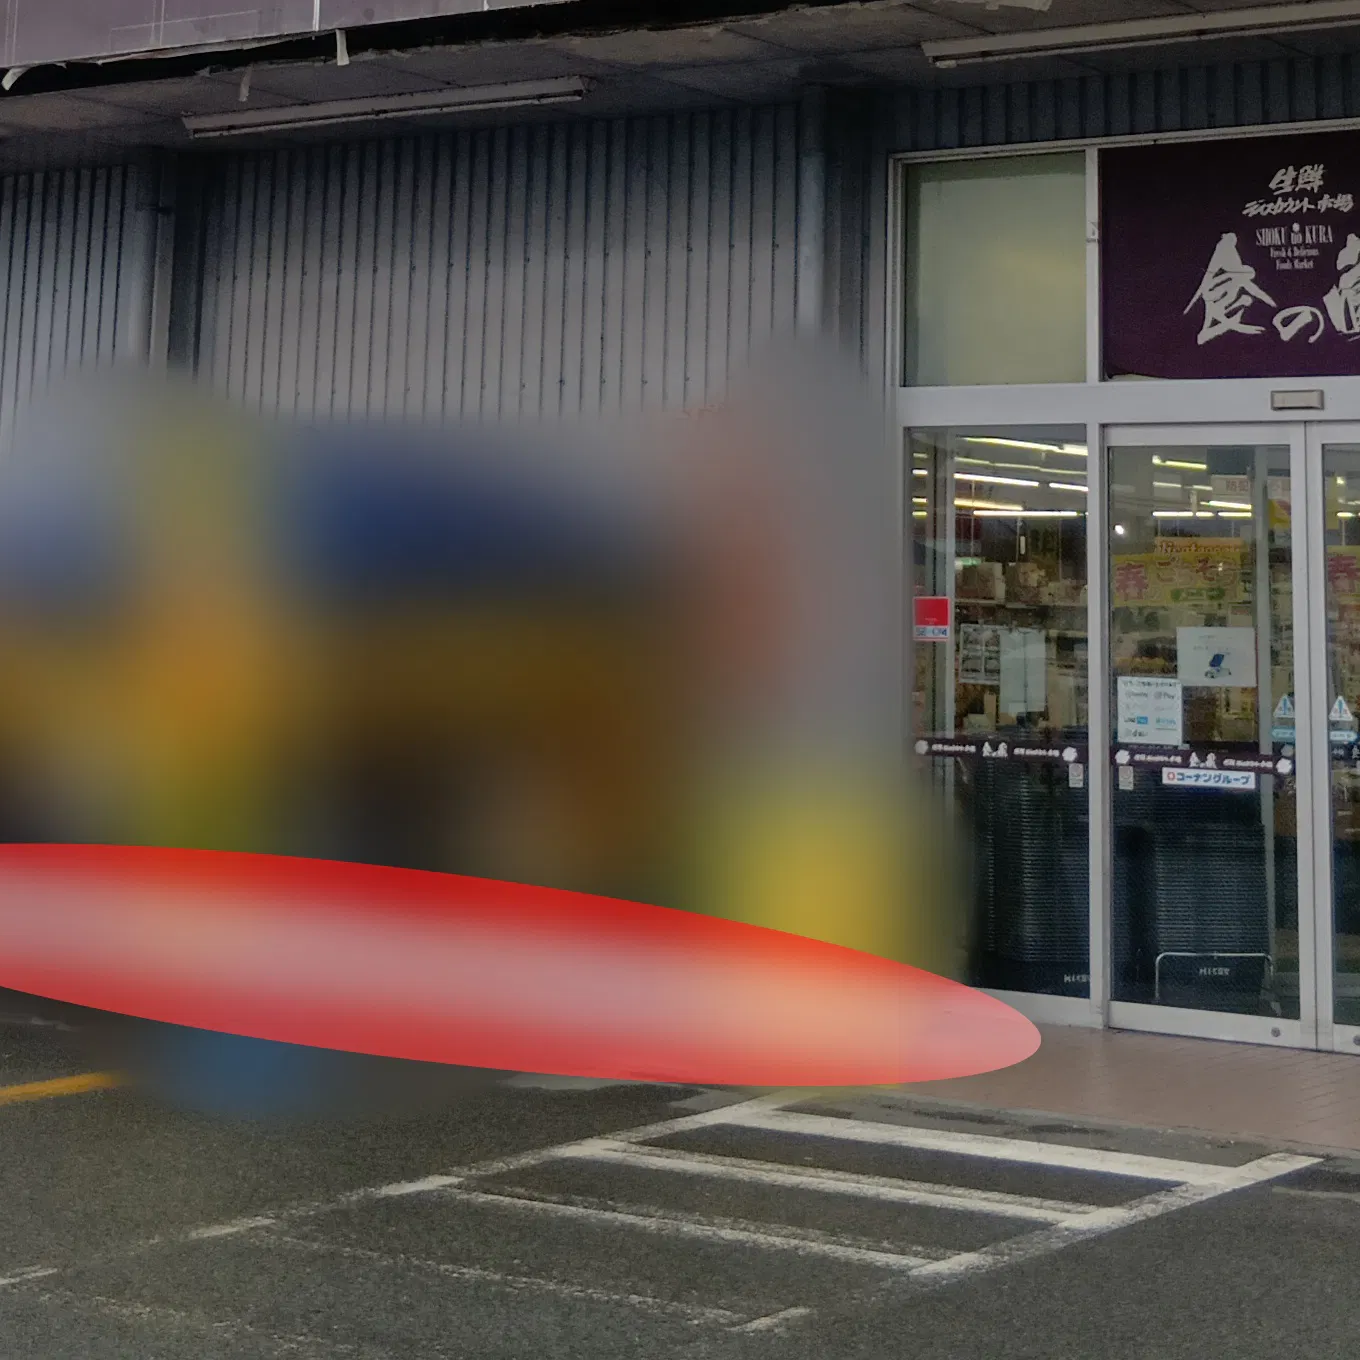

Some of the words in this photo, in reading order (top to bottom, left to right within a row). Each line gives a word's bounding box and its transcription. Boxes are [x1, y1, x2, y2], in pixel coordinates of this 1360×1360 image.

[1268, 164, 1325, 195] 生鮮
[1256, 227, 1286, 246] SHOKU
[1305, 225, 1333, 244] KURA
[1177, 771, 1251, 784] コーナングループ
